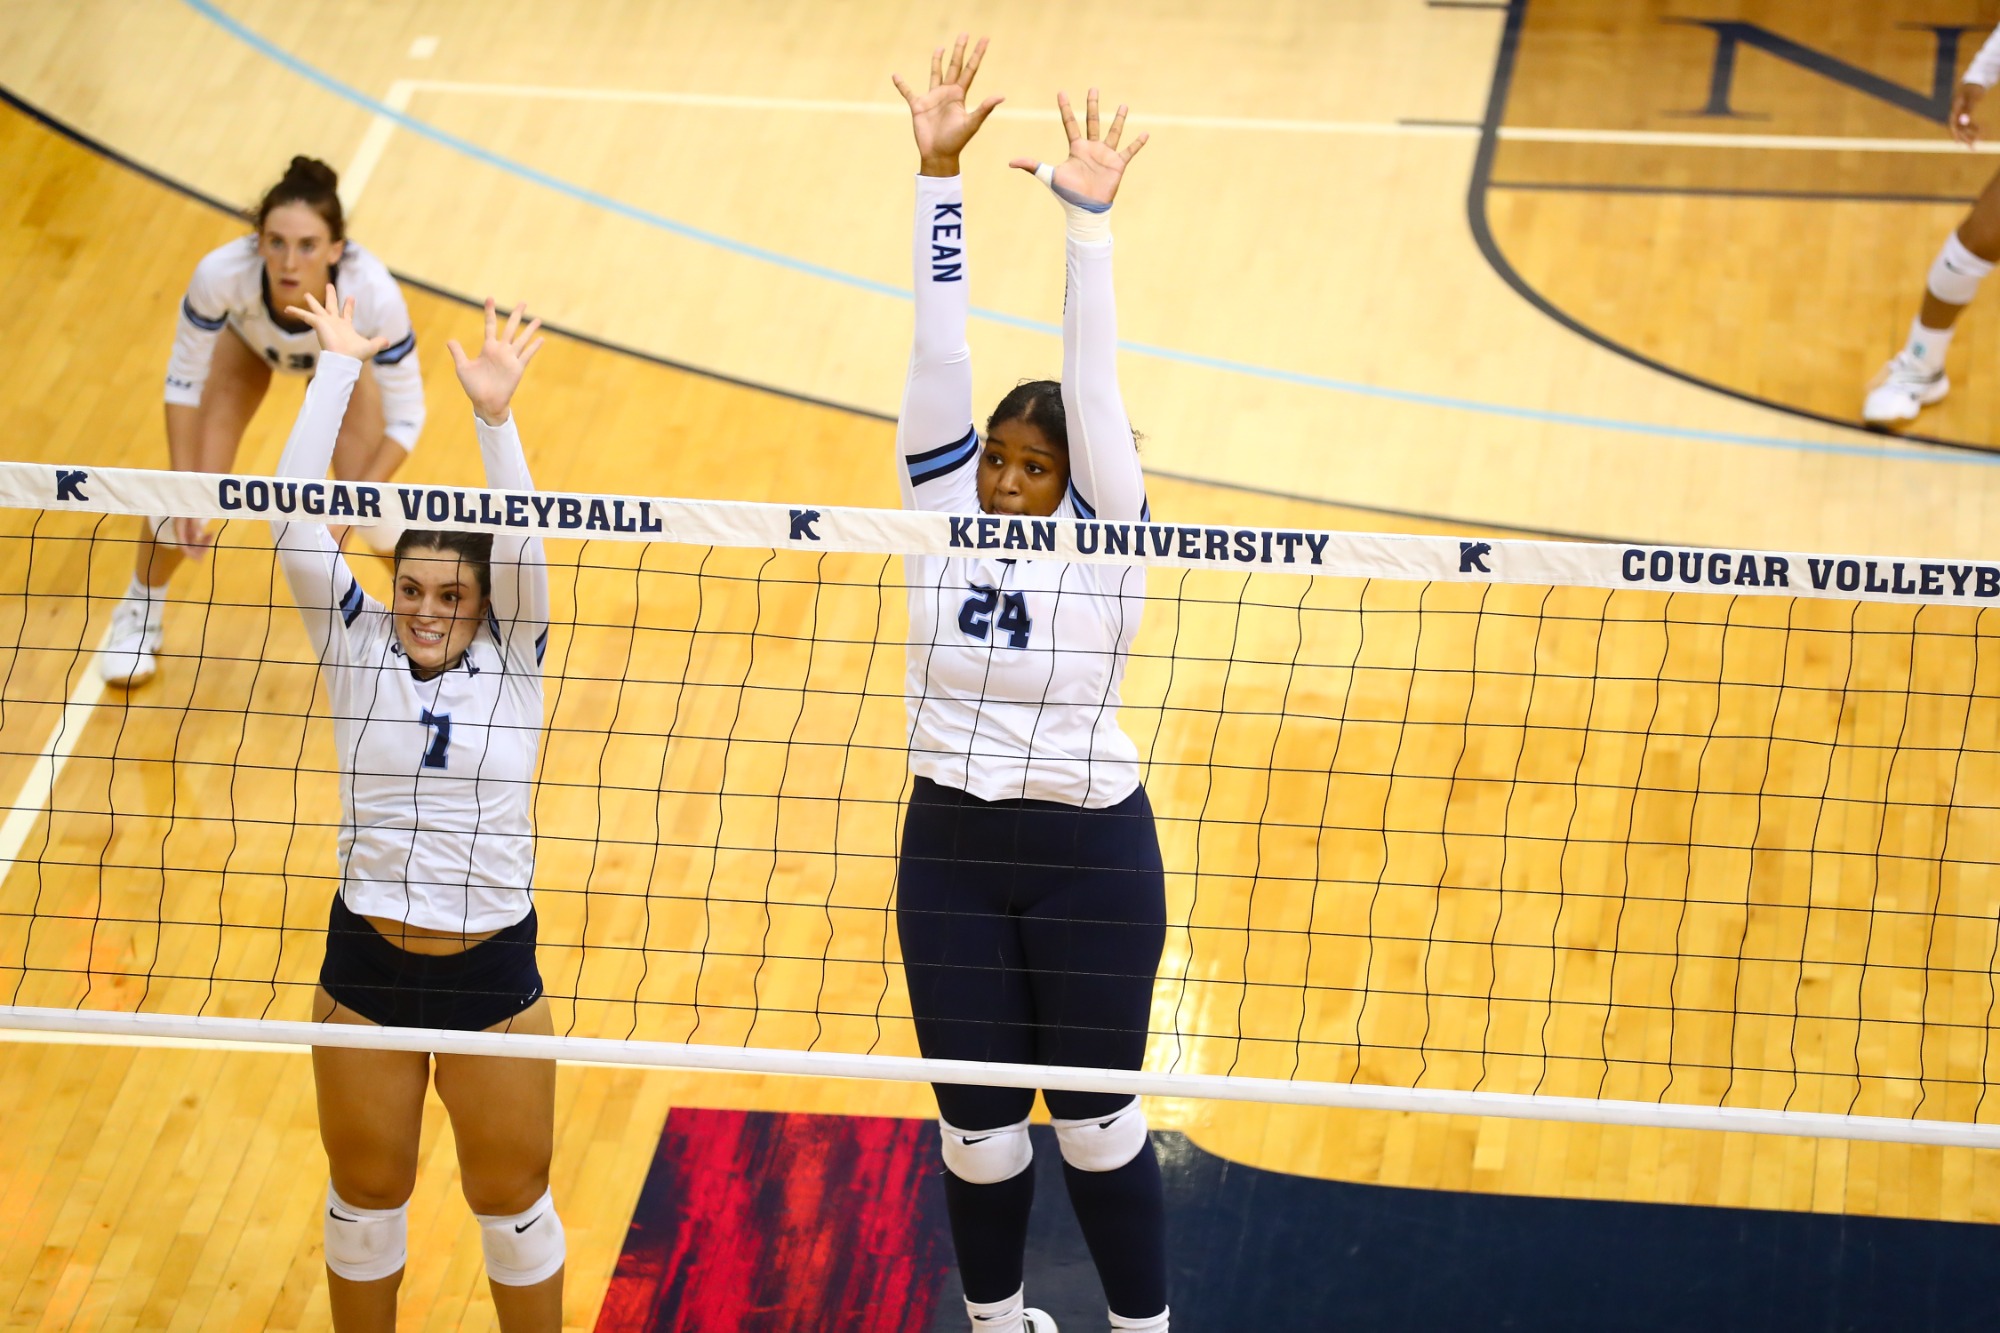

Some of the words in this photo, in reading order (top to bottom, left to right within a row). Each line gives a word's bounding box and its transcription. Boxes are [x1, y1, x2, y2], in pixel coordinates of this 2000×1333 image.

[932, 202, 963, 283] KEAN
[218, 478, 383, 518] COUGAR
[397, 488, 663, 533] VOLLEYBALL
[949, 516, 1059, 552] KEAN
[1074, 522, 1330, 565] UNIVERSITY
[1622, 549, 1789, 588] COUGAR
[1807, 558, 2000, 598] VOLLEYB
[958, 583, 1033, 650] 24
[419, 705, 453, 770] 7
